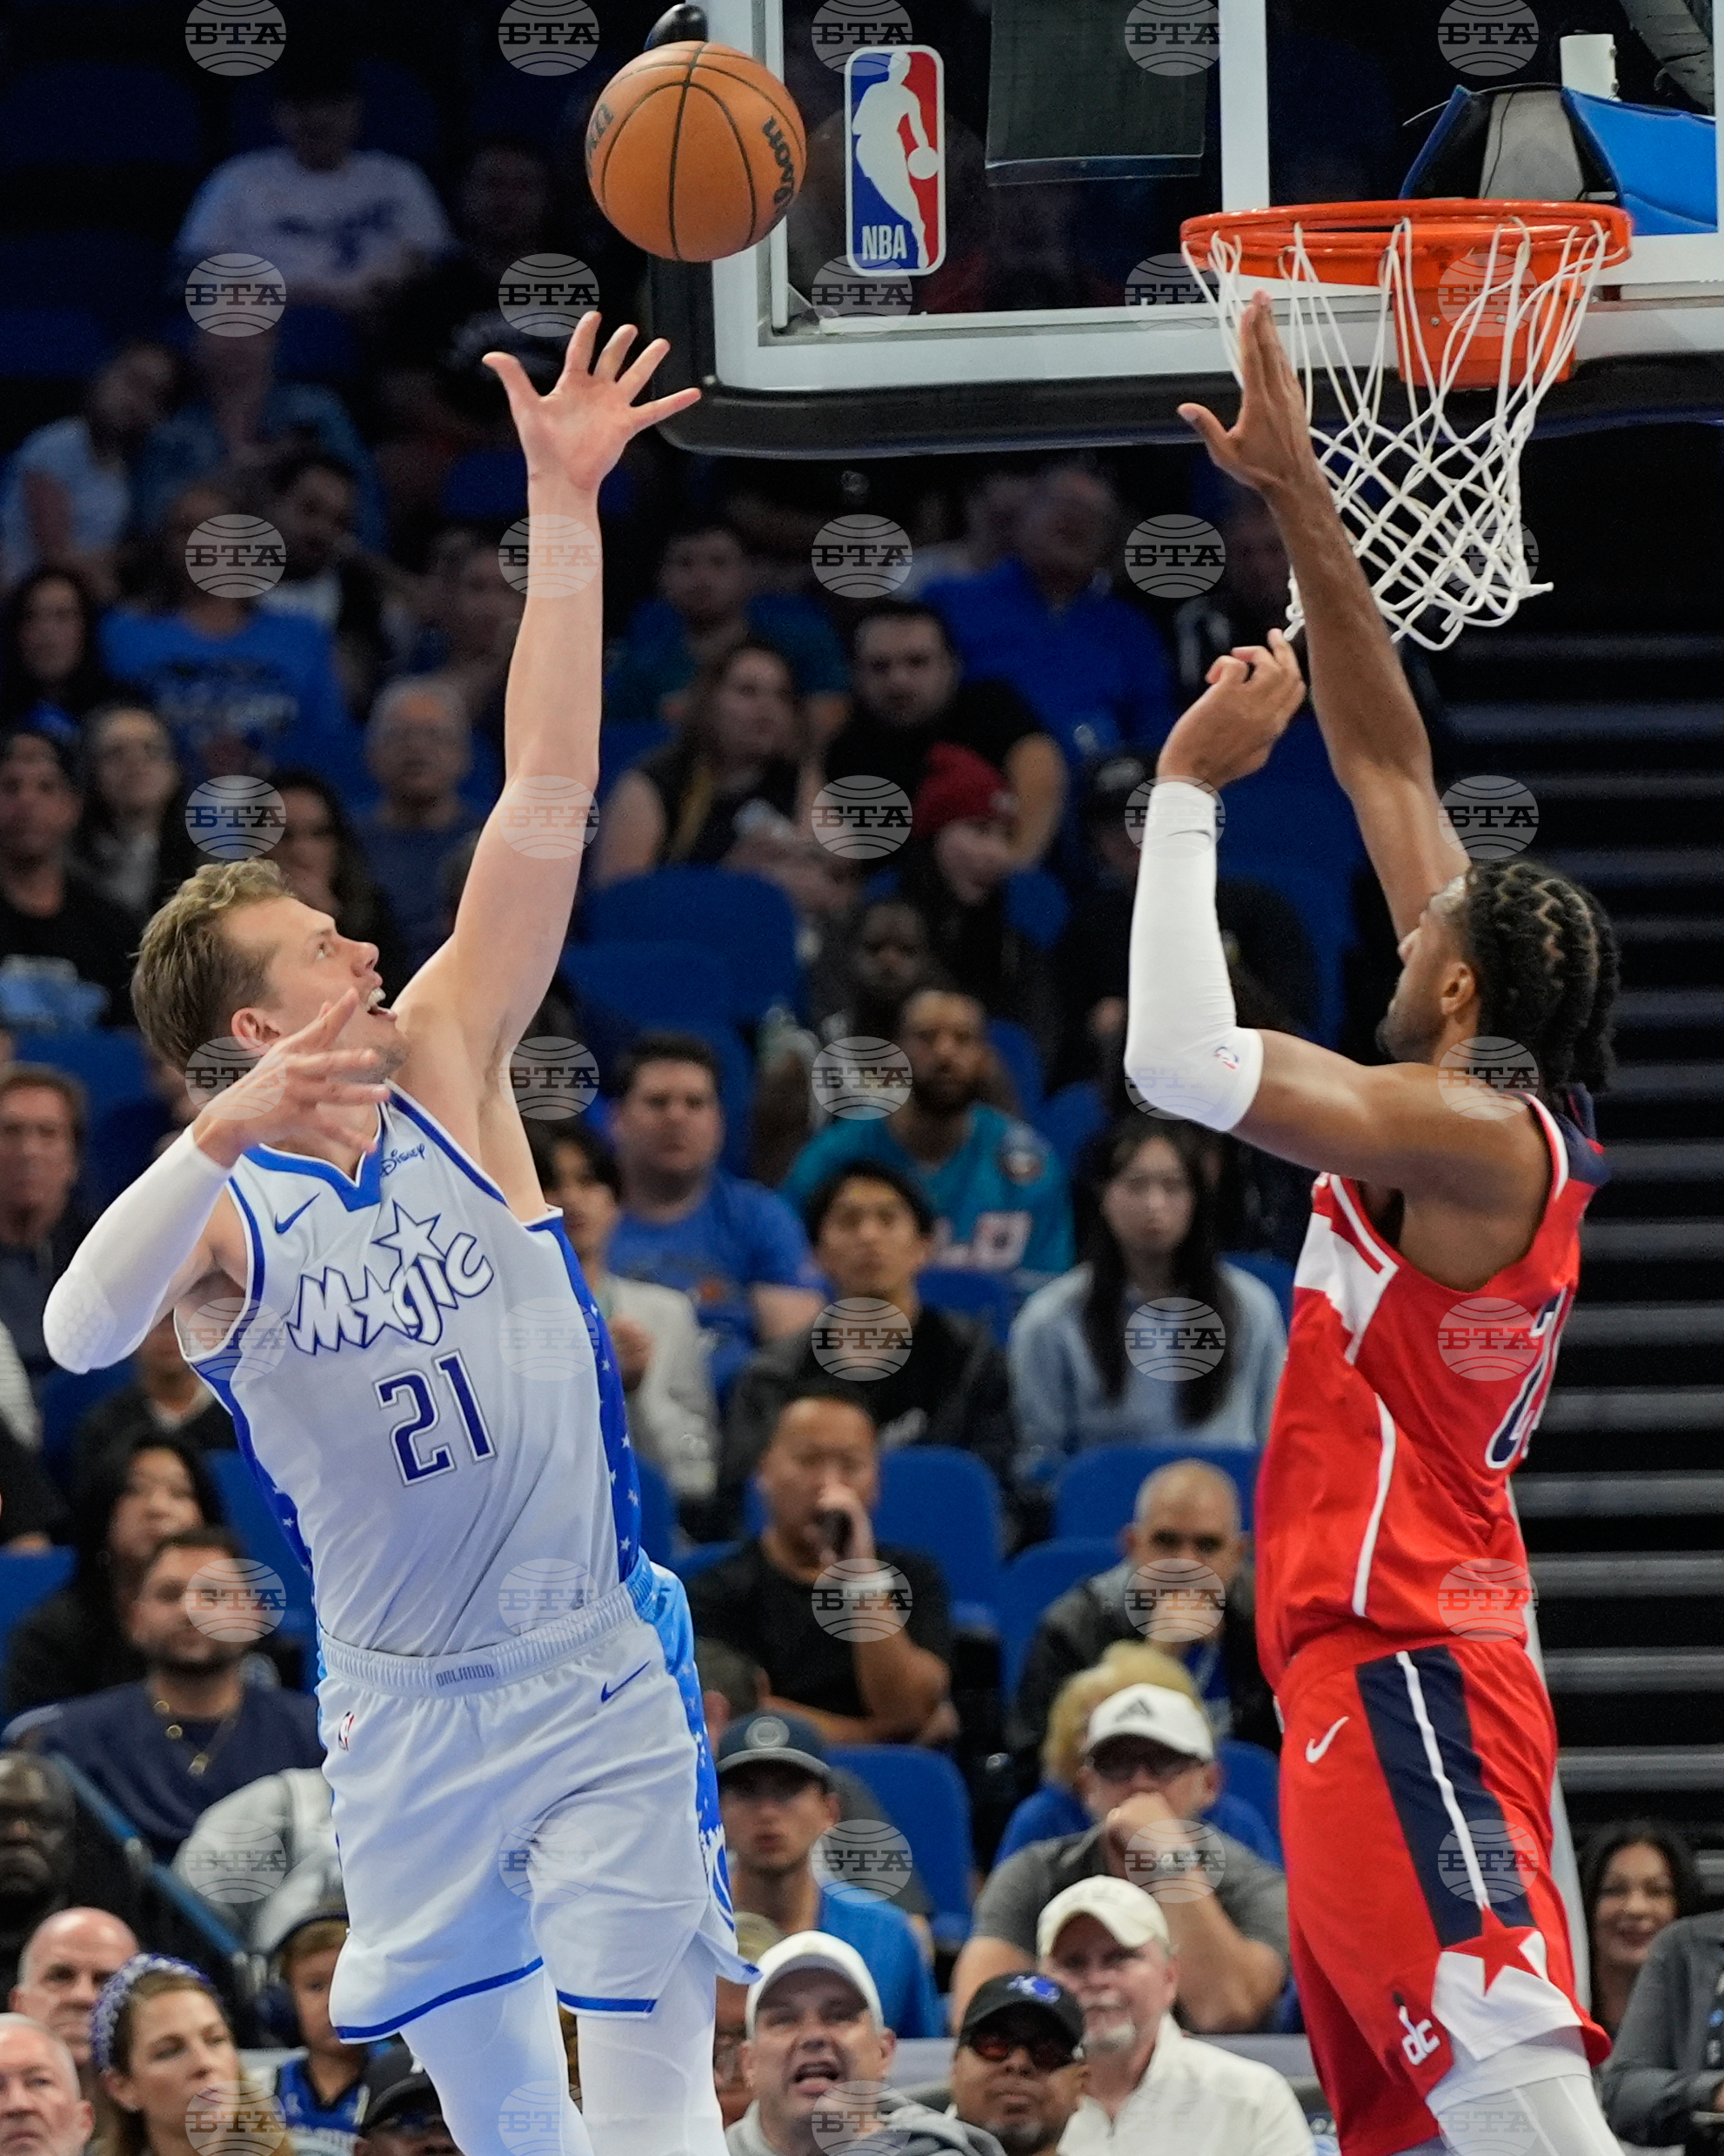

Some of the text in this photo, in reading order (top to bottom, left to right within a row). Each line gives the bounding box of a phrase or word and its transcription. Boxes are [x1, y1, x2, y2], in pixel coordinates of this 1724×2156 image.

[861, 224, 907, 261] NBA
[379, 1142, 425, 1178] Disney
[372, 1349, 498, 1488] 21
[435, 1664, 495, 1687] ORLANDO
